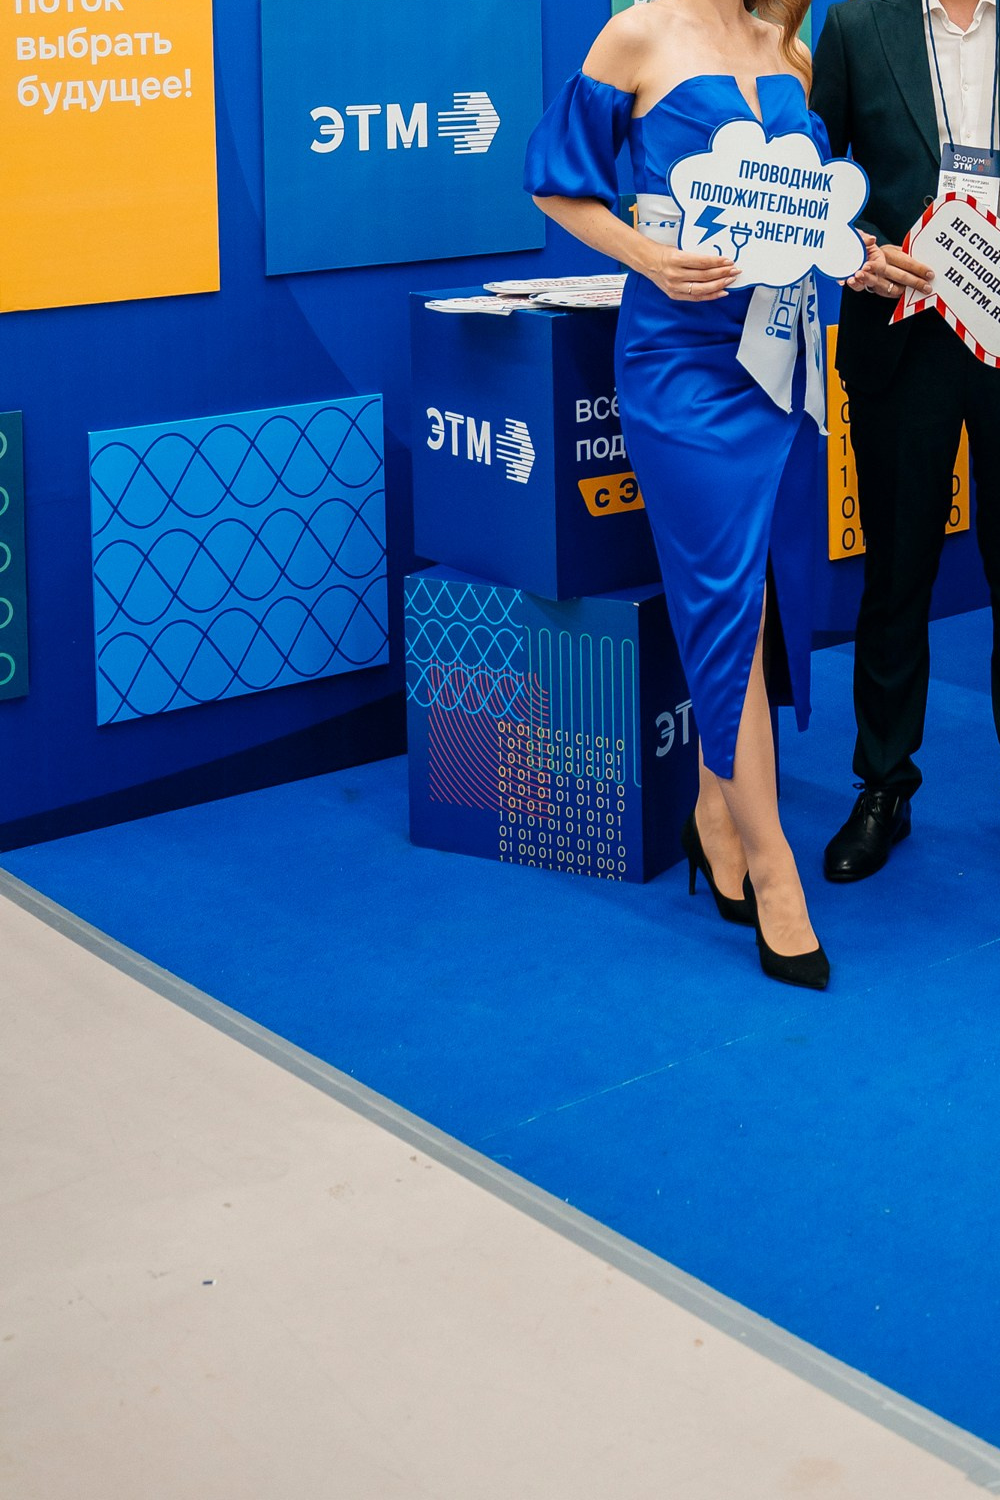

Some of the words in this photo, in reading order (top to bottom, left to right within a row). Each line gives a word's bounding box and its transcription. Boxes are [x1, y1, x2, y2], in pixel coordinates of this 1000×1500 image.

[16, 27, 172, 65] выбрать
[17, 69, 192, 115] будущее!
[310, 103, 427, 153] ЭТМ
[739, 160, 834, 192] ПРОВОДНИК
[690, 181, 829, 220] ПОЛОЖИТЕЛЬНОЙ
[755, 220, 825, 249] ЭНЕРГИИ
[935, 231, 953, 251] ЗА
[950, 217, 971, 238] НЕ
[944, 267, 964, 287] НА
[426, 408, 490, 465] ЭТМ
[576, 435, 626, 462] под
[655, 699, 692, 757] ЭТ
